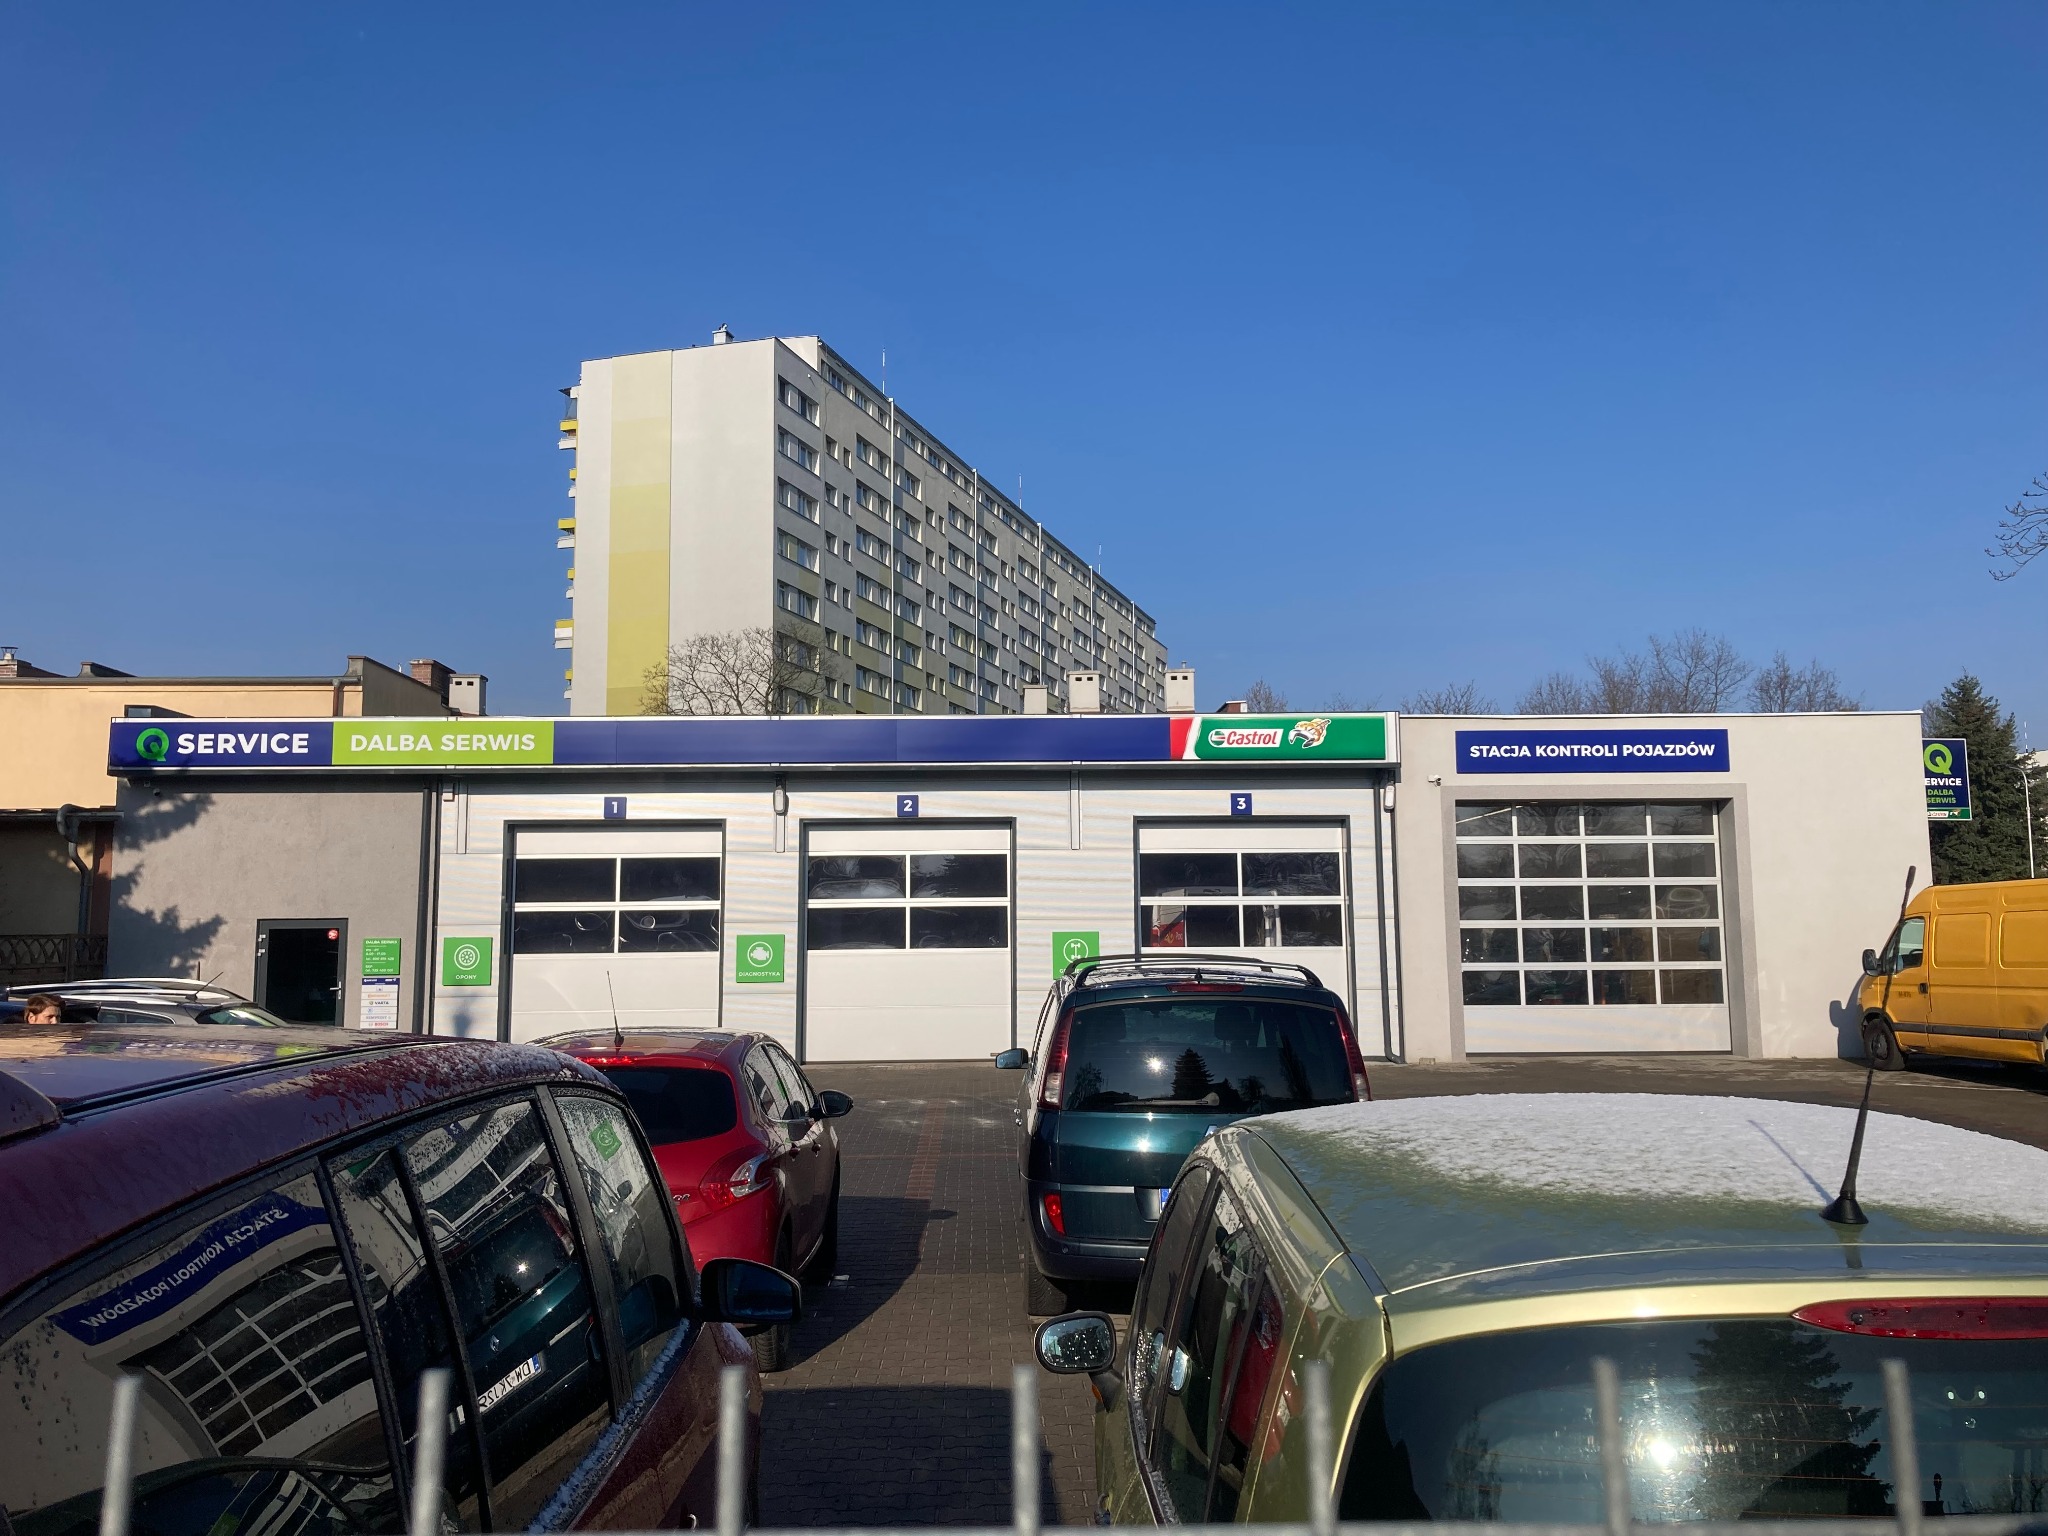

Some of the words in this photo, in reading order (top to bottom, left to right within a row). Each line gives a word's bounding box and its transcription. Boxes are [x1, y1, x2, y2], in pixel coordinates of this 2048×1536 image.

[136, 727, 170, 762] Q
[177, 733, 309, 755] SERVICE
[351, 734, 433, 752] DALBA
[440, 734, 536, 752] SERWIS
[1226, 730, 1278, 746] Castrol
[1470, 745, 1532, 758] STACJA
[1535, 744, 1618, 758] KONTROLI
[1622, 741, 1716, 757] POJAZDÓW
[1924, 743, 1952, 775] Q
[1924, 778, 1962, 786] ERVICE
[611, 801, 619, 814] 1
[903, 799, 913, 812] 2
[1236, 798, 1247, 810] 3
